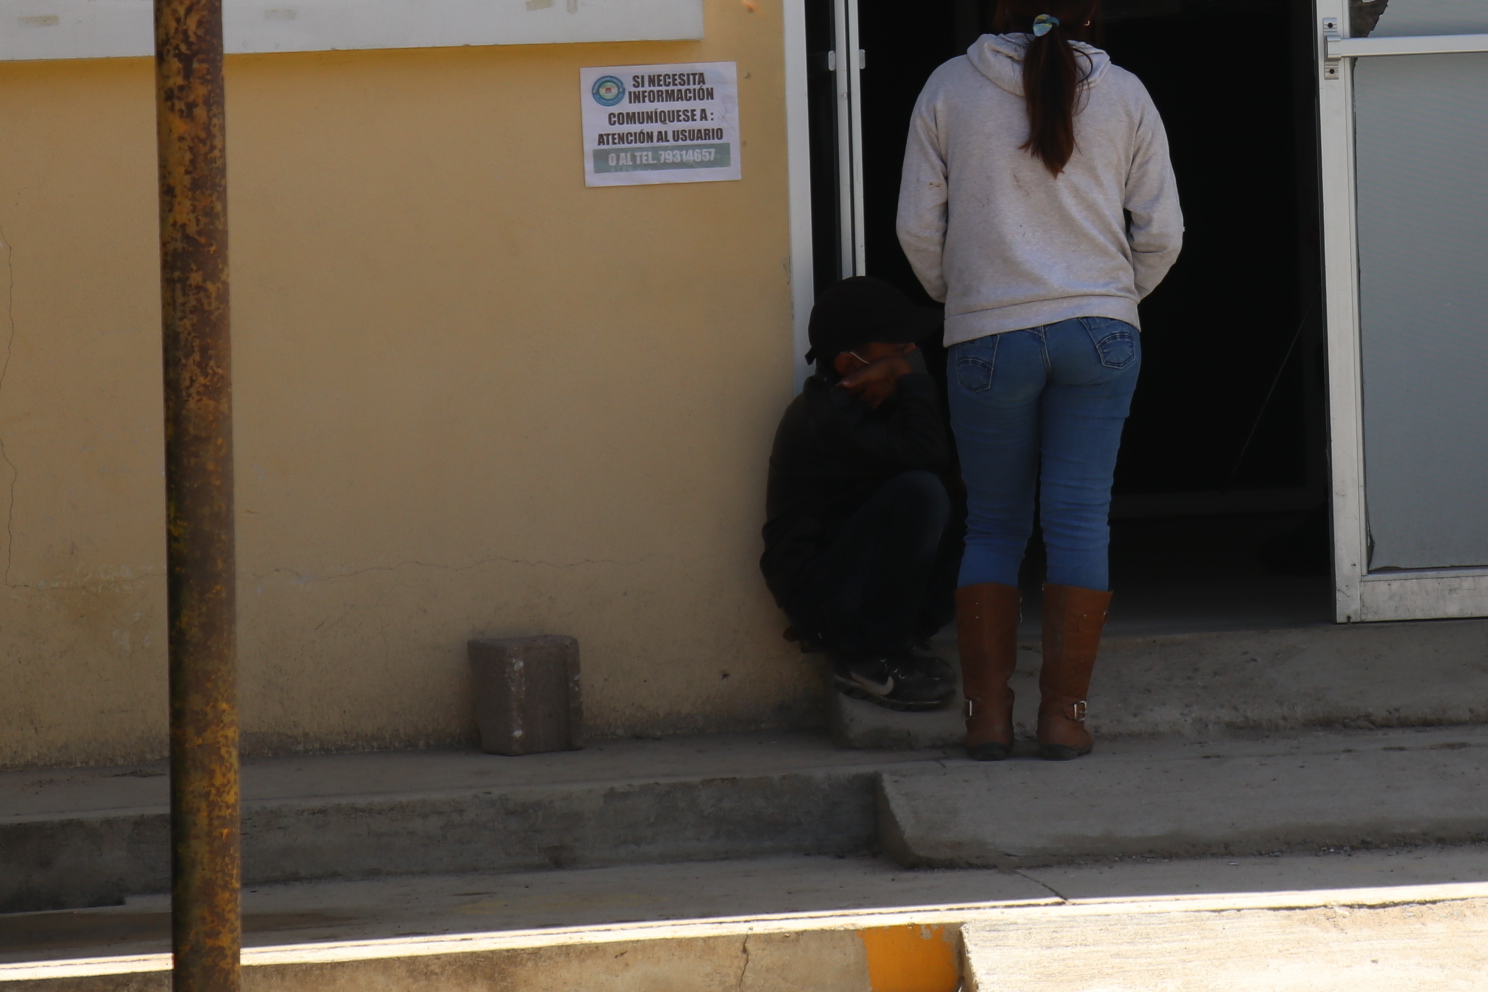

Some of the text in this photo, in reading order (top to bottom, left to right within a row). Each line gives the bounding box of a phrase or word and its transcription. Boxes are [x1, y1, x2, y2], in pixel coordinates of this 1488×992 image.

[632, 73, 706, 88] SI NECESITA
[628, 87, 714, 104] INFORMACIÓN
[608, 109, 696, 126] COMUNÍQUESE
[598, 128, 723, 146] ATENCIÓN AL USUARIO
[619, 152, 632, 165] AL
[635, 152, 657, 164] TEL.
[659, 148, 715, 163] 79314657
